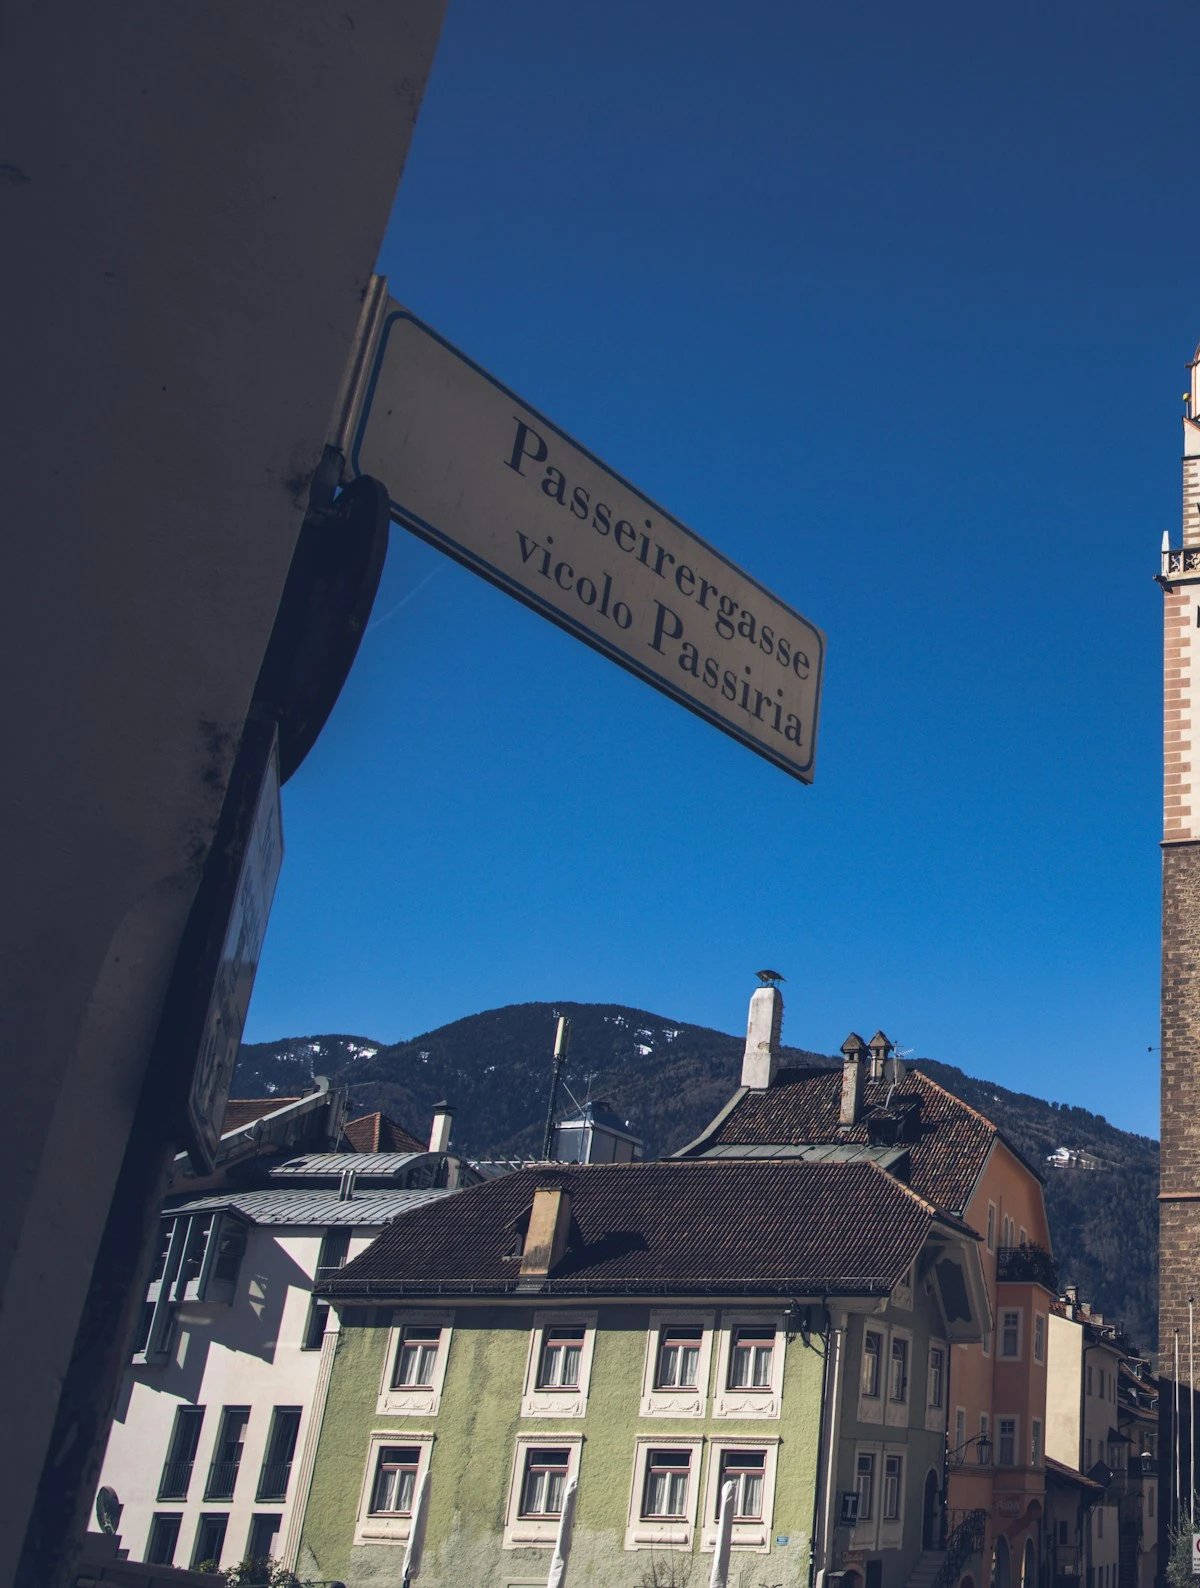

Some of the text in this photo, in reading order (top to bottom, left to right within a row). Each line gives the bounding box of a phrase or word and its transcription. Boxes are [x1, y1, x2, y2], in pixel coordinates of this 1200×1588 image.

[503, 416, 810, 680] Passeirergasse
[516, 530, 803, 747] vicolo Passiria
